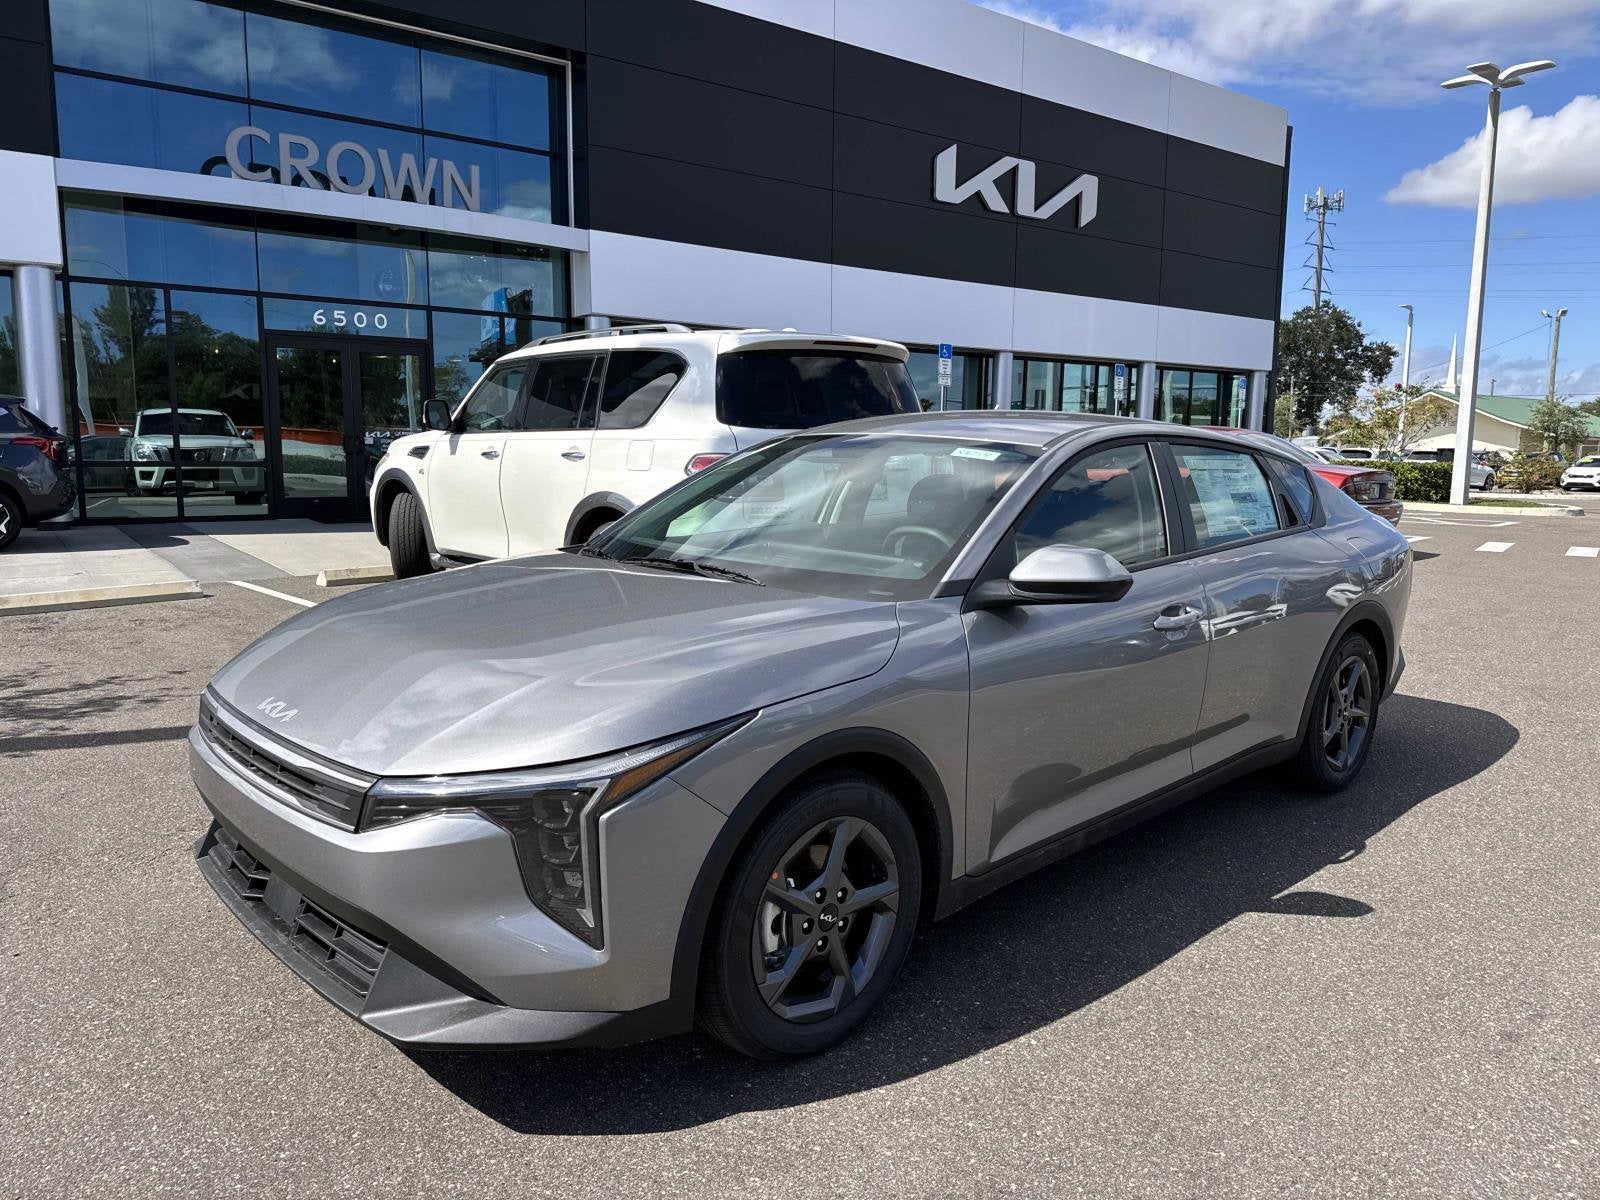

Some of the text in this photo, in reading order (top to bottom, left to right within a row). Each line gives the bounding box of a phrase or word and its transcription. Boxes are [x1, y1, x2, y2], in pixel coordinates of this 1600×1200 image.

[225, 126, 480, 212] CROWN
[935, 144, 1098, 228] KIA
[313, 309, 388, 329] 6500
[257, 696, 299, 722] KIA
[820, 913, 838, 922] KIA
